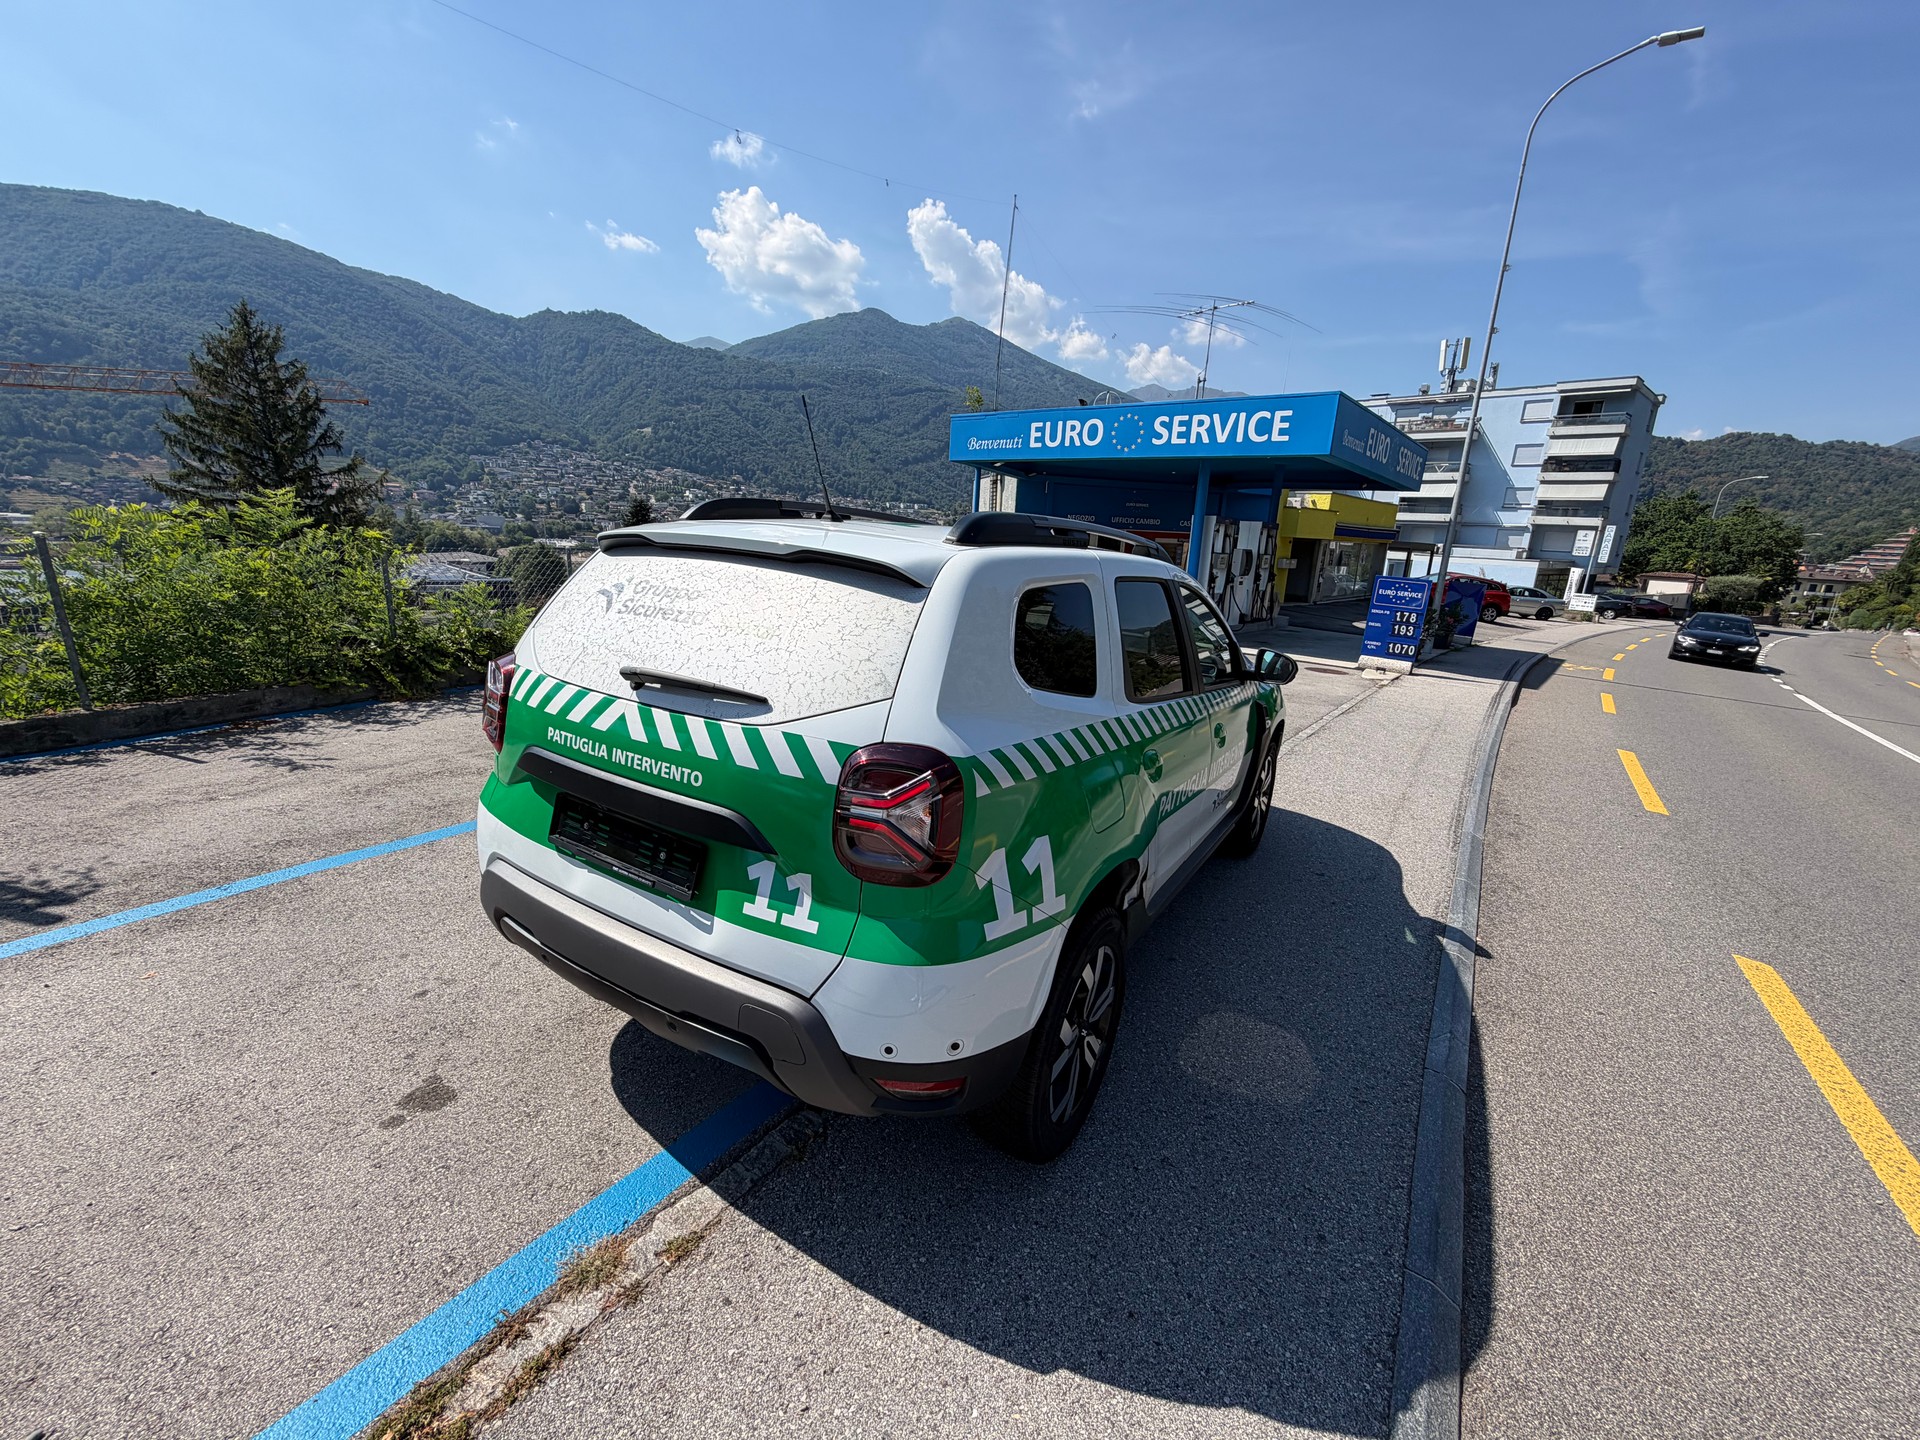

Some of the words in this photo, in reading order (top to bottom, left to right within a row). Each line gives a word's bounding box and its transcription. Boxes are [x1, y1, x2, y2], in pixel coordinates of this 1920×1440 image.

[967, 434, 1024, 450] Benvenuti
[1029, 418, 1104, 448] EURO
[1151, 409, 1293, 445] SERVICE
[1366, 427, 1390, 464] EURO
[1396, 446, 1423, 480] SERVICE
[1067, 514, 1096, 522] NEGOZIO
[1135, 518, 1161, 526] CAMBIO
[1600, 527, 1614, 561] GARAGE
[632, 579, 702, 603] Gruppo
[616, 598, 707, 626] Sicurezza
[1396, 611, 1417, 622] 178
[1393, 624, 1414, 636] 193
[1389, 643, 1415, 655] 1070
[547, 726, 608, 760] PATTUGLIA
[611, 747, 703, 787] INTERVENTO
[1158, 767, 1208, 820] PATTUGLIA
[742, 860, 819, 935] 11
[974, 834, 1067, 942] 11
